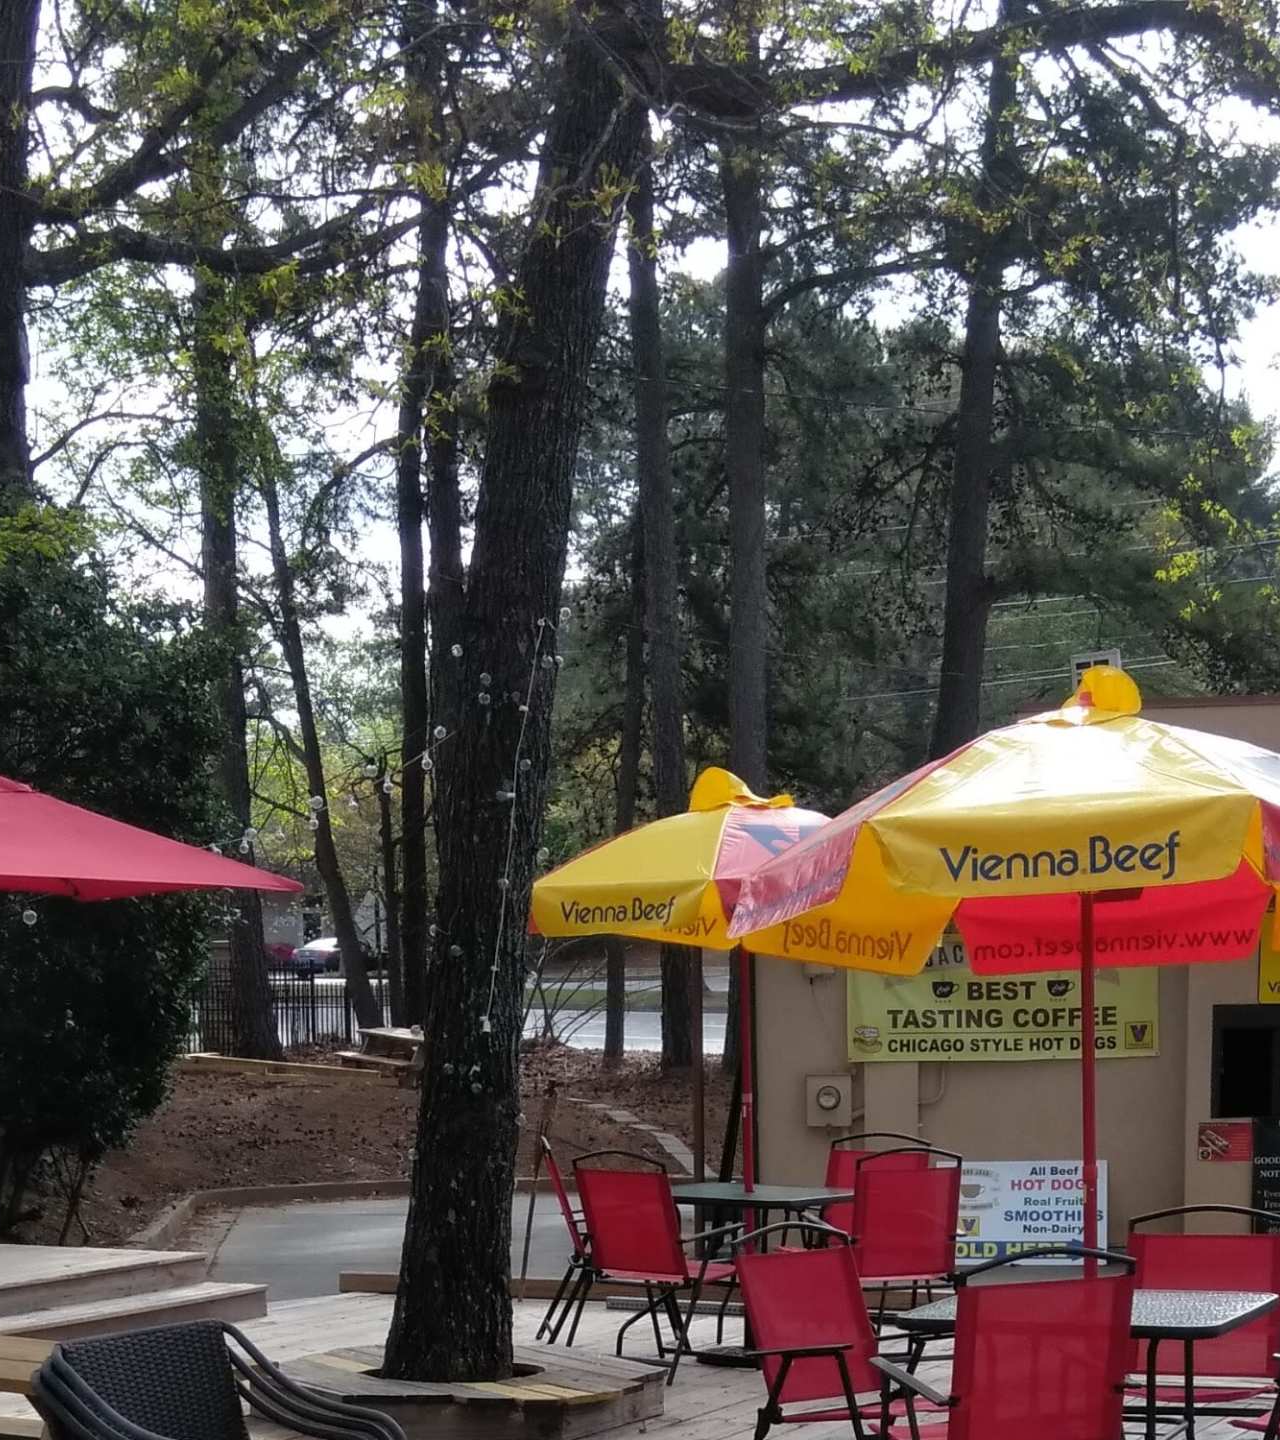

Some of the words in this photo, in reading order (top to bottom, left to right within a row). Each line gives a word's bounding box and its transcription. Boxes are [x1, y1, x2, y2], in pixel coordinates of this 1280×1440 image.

[941, 844, 1077, 883] Vienna
[1089, 830, 1181, 878] Beef
[560, 900, 627, 925] Vienna
[630, 895, 676, 922] Beef
[967, 981, 1037, 1001] BEST
[887, 1008, 1004, 1029] TASTING
[888, 1038, 964, 1053] CHICAGO
[970, 1037, 1024, 1052] STYLE
[1029, 1036, 1064, 1051] HOT
[1070, 1035, 1117, 1050] DGS
[1030, 1166, 1046, 1176] All
[1050, 1166, 1079, 1176] Beef
[1260, 1170, 1280, 1178] NOT
[1010, 1179, 1045, 1191] HOT
[1024, 1197, 1051, 1206] Real
[1055, 1196, 1085, 1206] Fruit
[1004, 1210, 1104, 1222] SMOOTHIS
[1023, 1224, 1085, 1237] Non-Dairy
